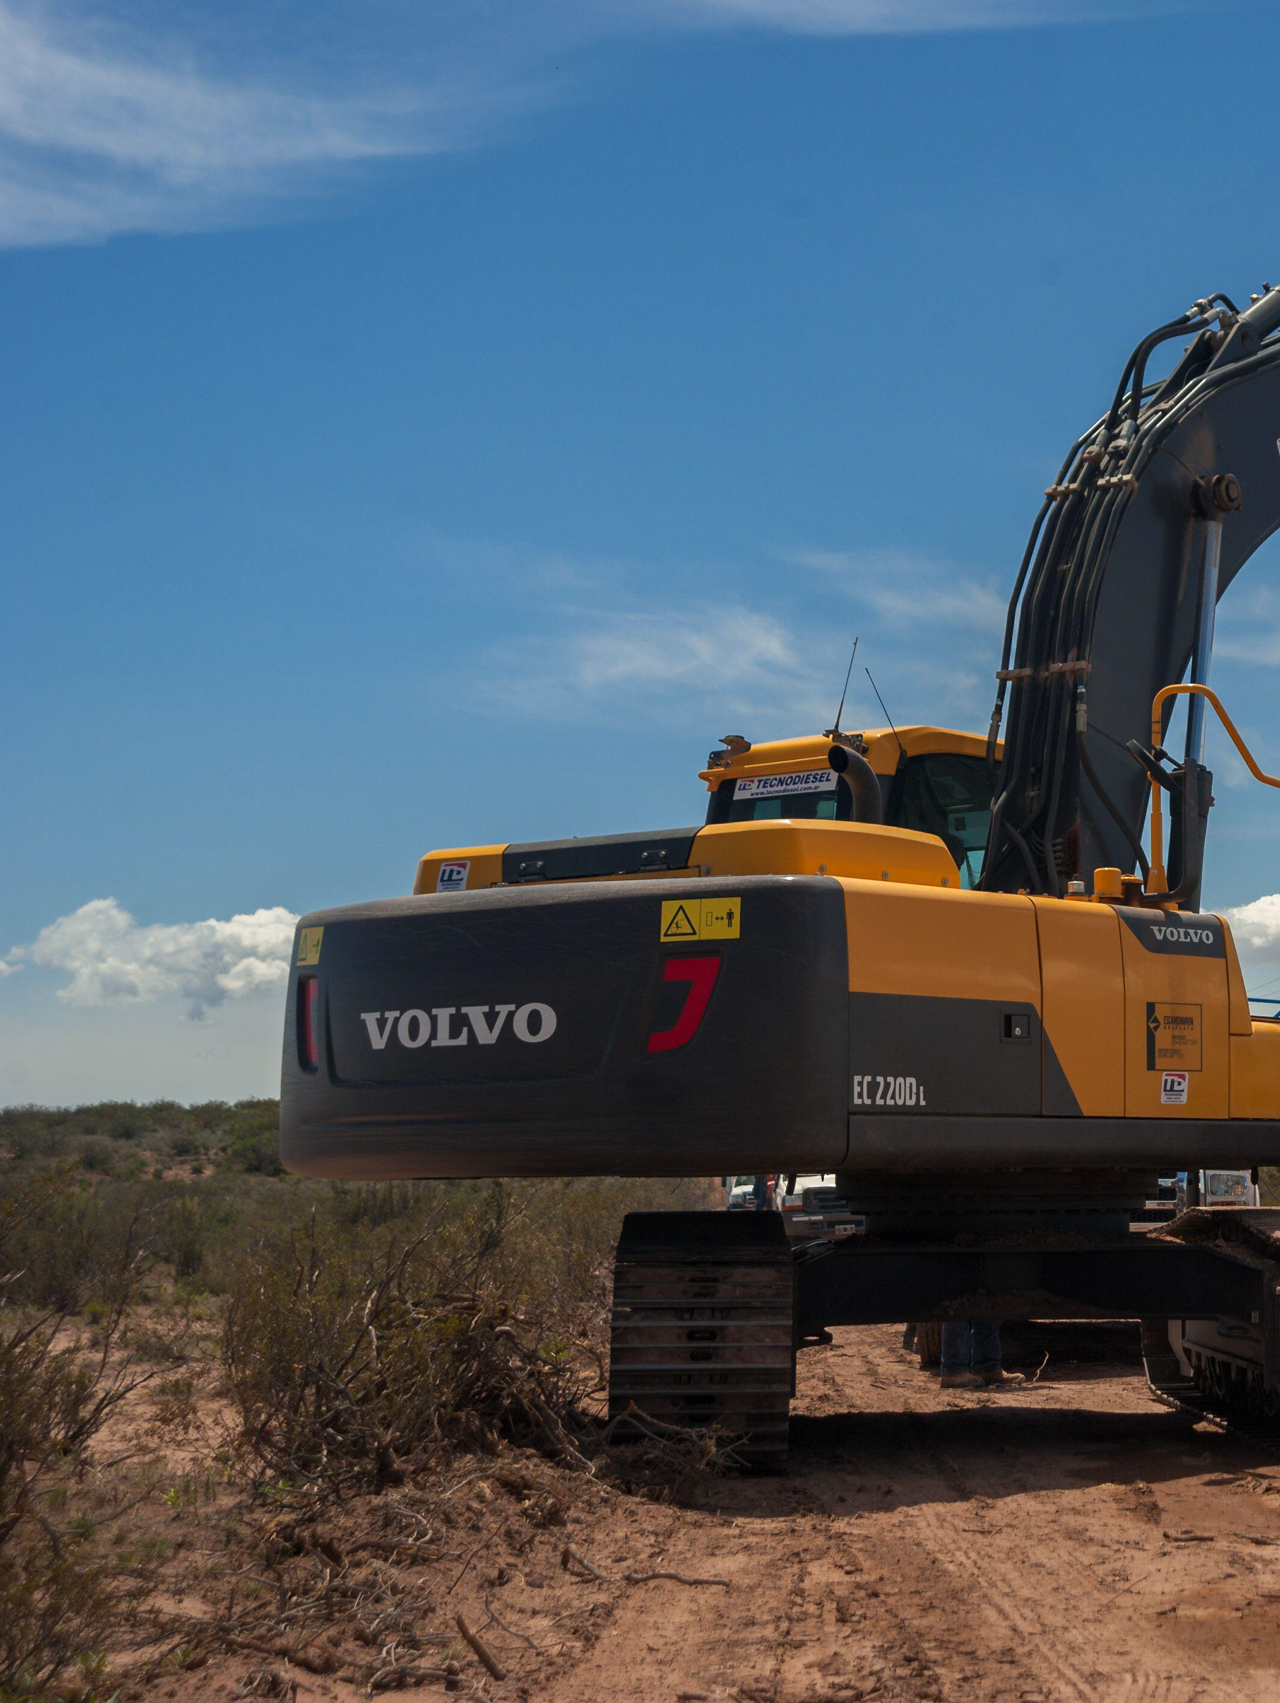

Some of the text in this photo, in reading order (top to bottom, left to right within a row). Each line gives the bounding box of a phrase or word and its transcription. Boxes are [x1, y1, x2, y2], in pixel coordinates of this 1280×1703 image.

[756, 771, 832, 790] TECNODIESEL
[750, 785, 820, 797] www.tecnodiesel.com.ar
[1150, 925, 1214, 945] VOLVO
[360, 1002, 557, 1050] VOLVO
[853, 1075, 872, 1105] EC
